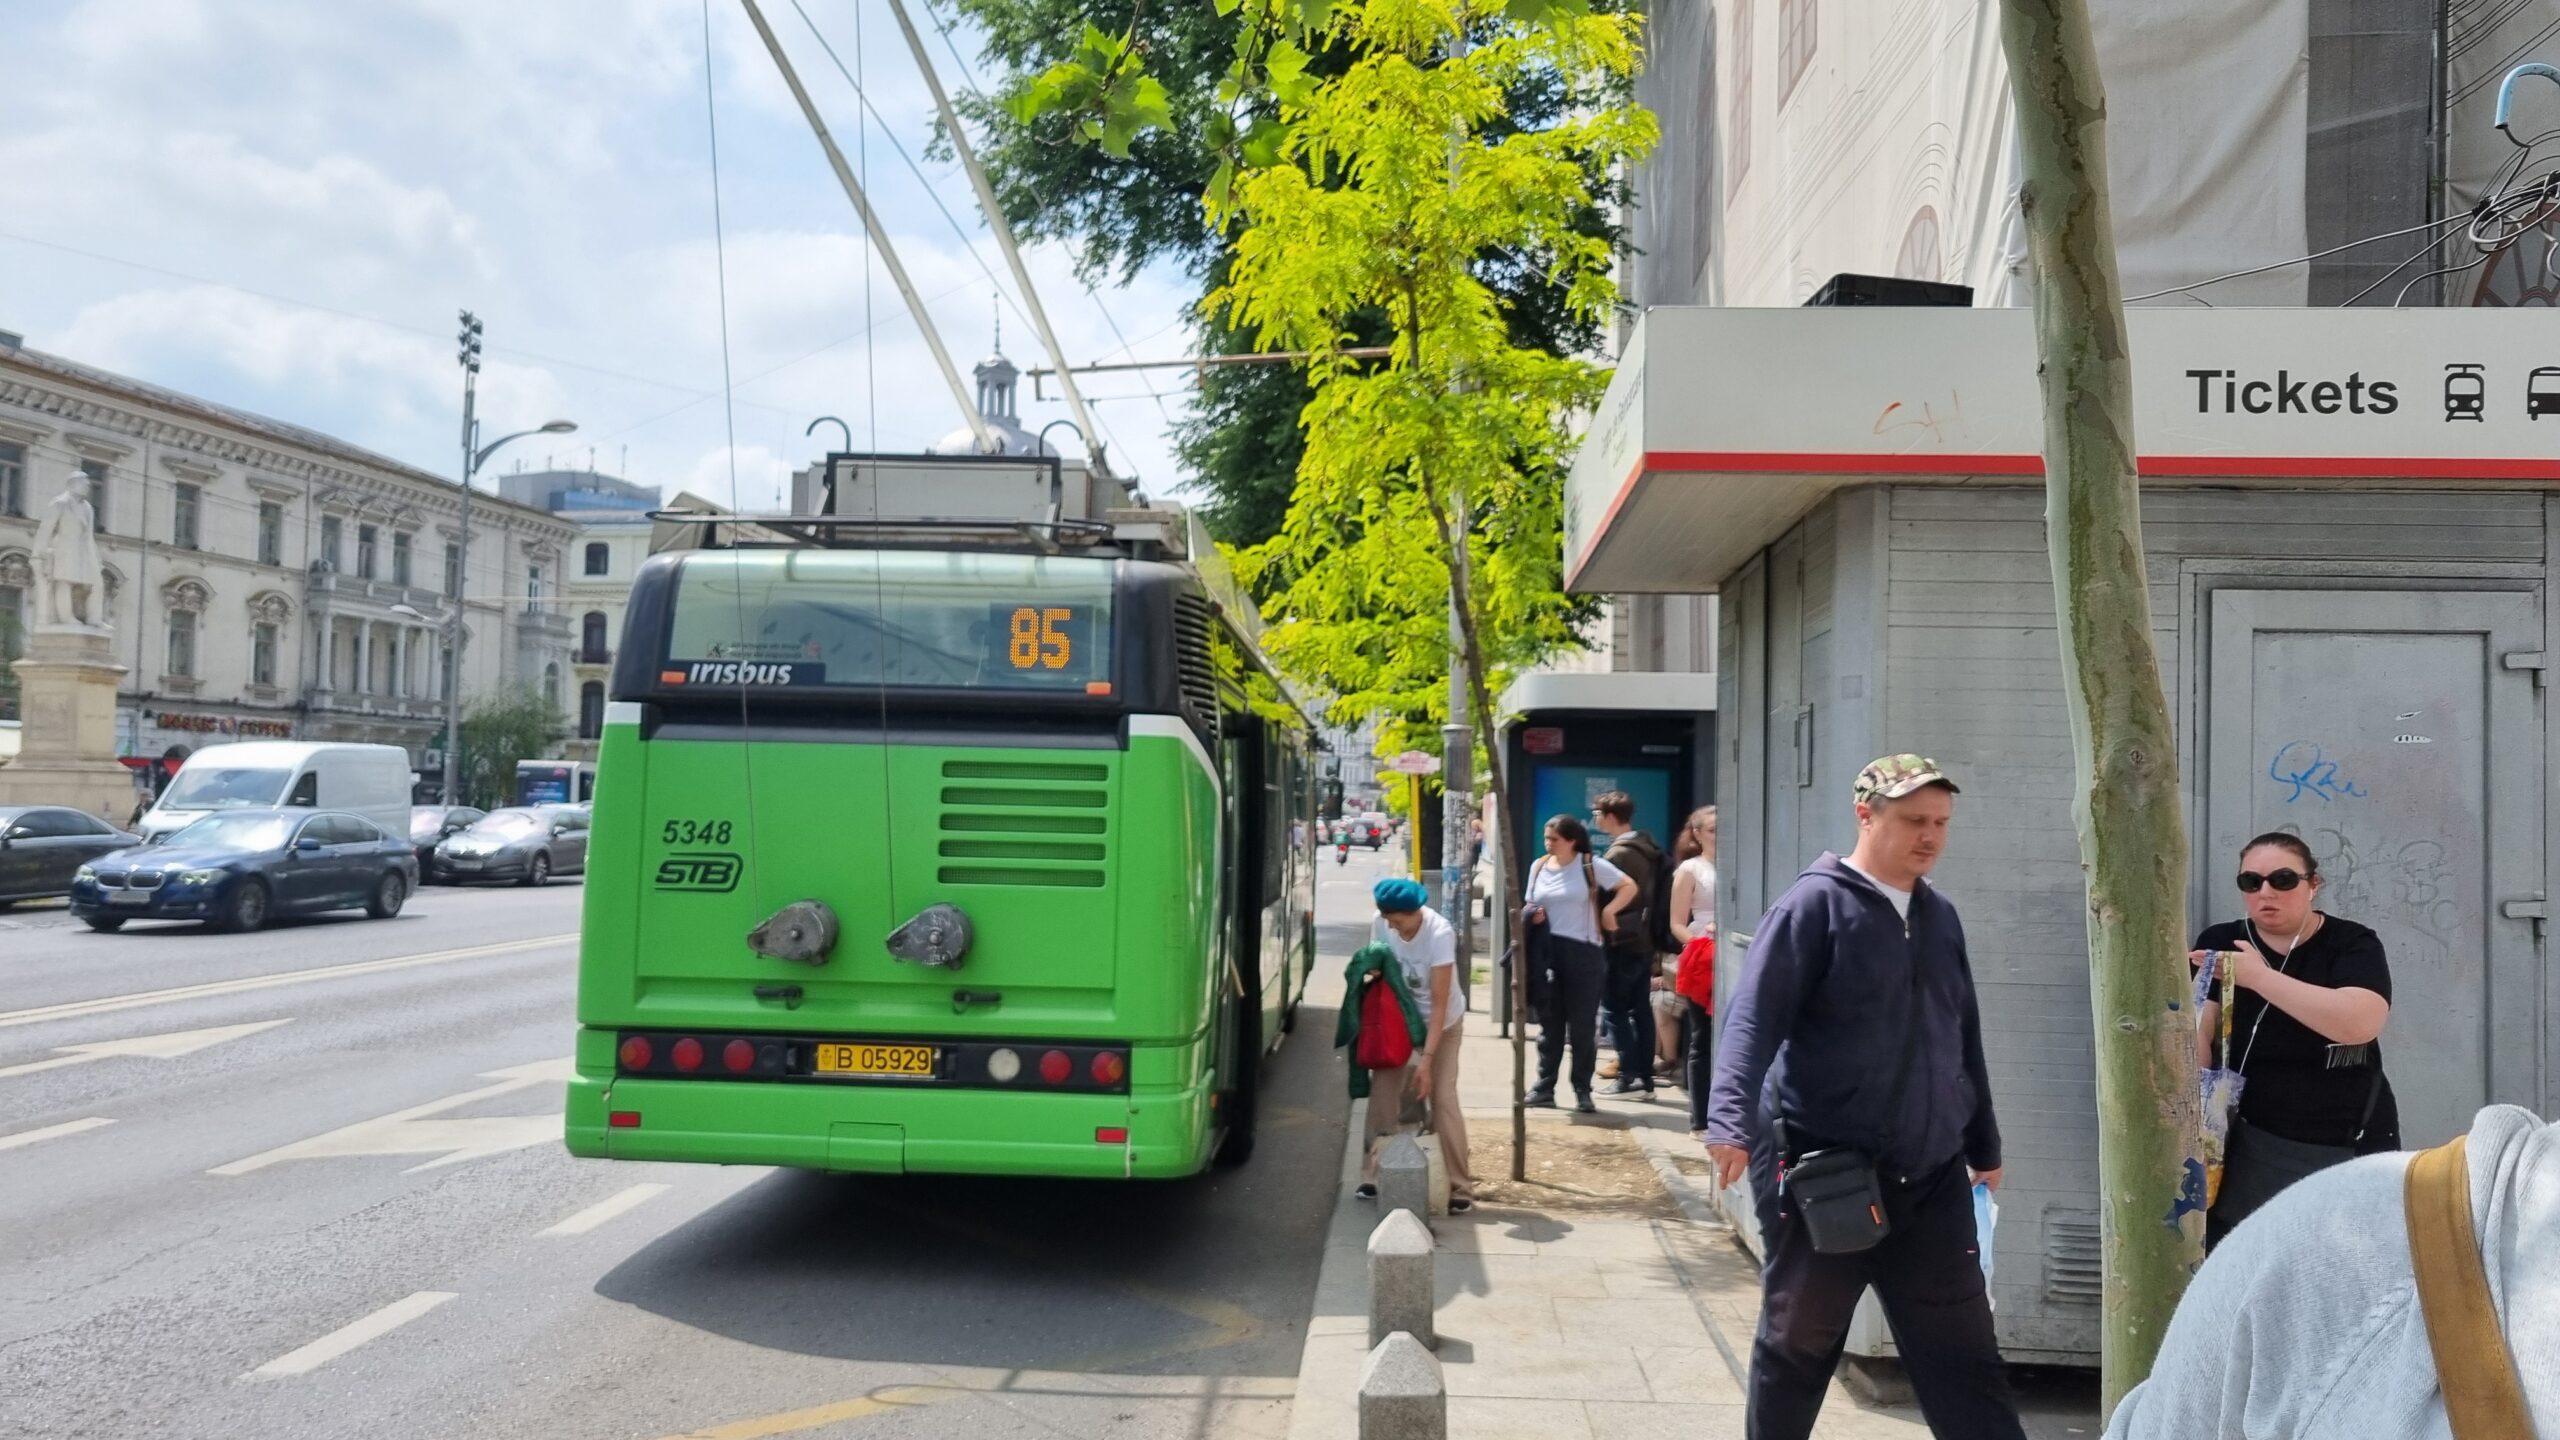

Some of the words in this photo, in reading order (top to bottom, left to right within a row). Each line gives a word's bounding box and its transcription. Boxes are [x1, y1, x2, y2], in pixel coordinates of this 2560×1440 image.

[2186, 370, 2399, 415] Tickets
[1009, 607, 1072, 669] 85
[662, 819, 733, 845] 5348
[655, 860, 734, 884] STB
[838, 1047, 853, 1069] B
[861, 1048, 930, 1071] 05929
